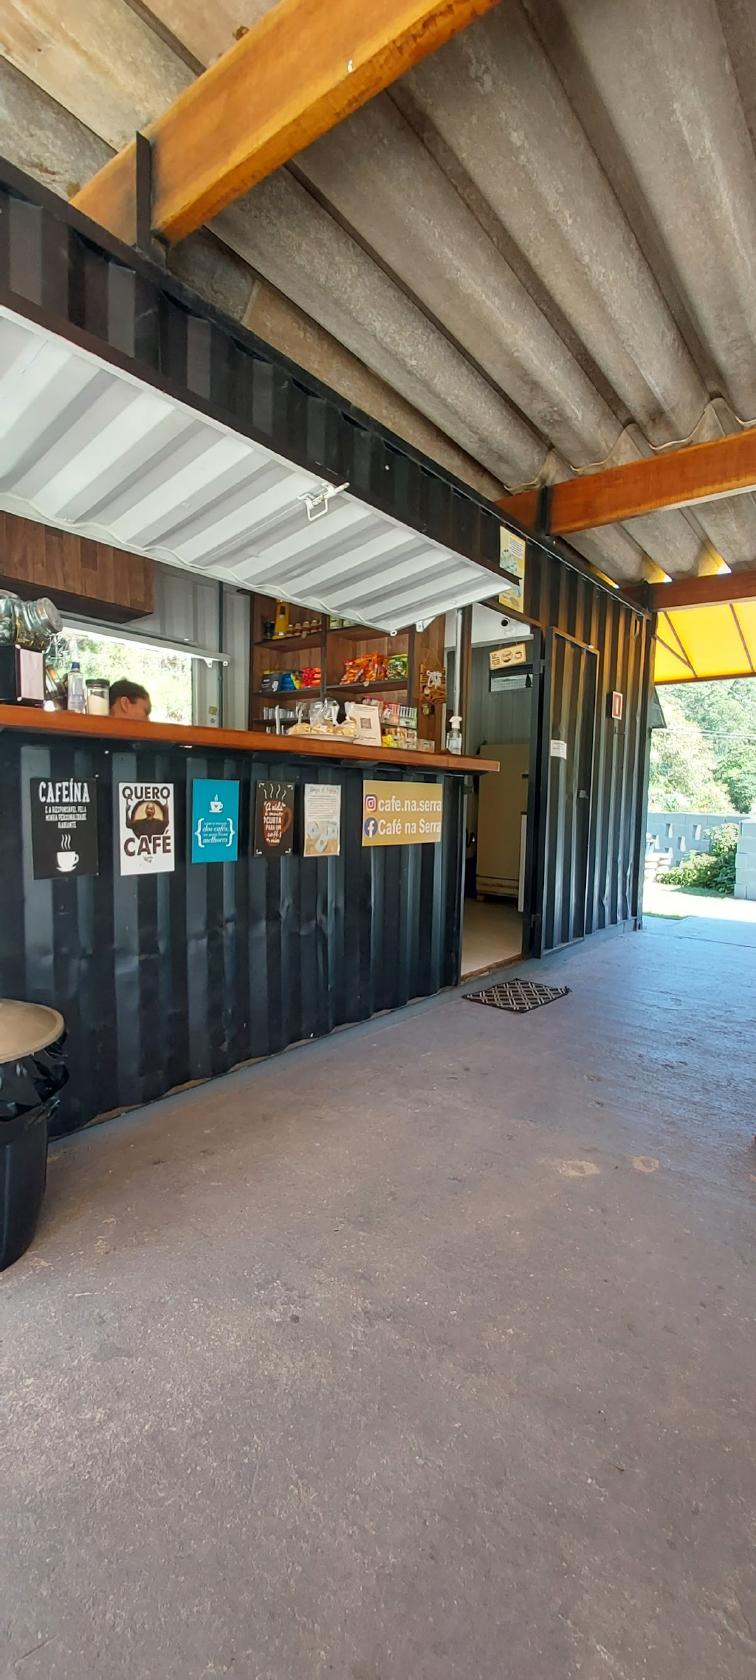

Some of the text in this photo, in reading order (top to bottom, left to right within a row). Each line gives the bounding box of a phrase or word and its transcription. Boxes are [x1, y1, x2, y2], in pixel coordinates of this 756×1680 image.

[39, 778, 90, 803] CAFEÍNA
[122, 785, 171, 801] QUERO
[378, 795, 442, 812] cafe.na.serra
[378, 818, 441, 835] Café na Serra
[123, 829, 172, 857] CAFÉ
